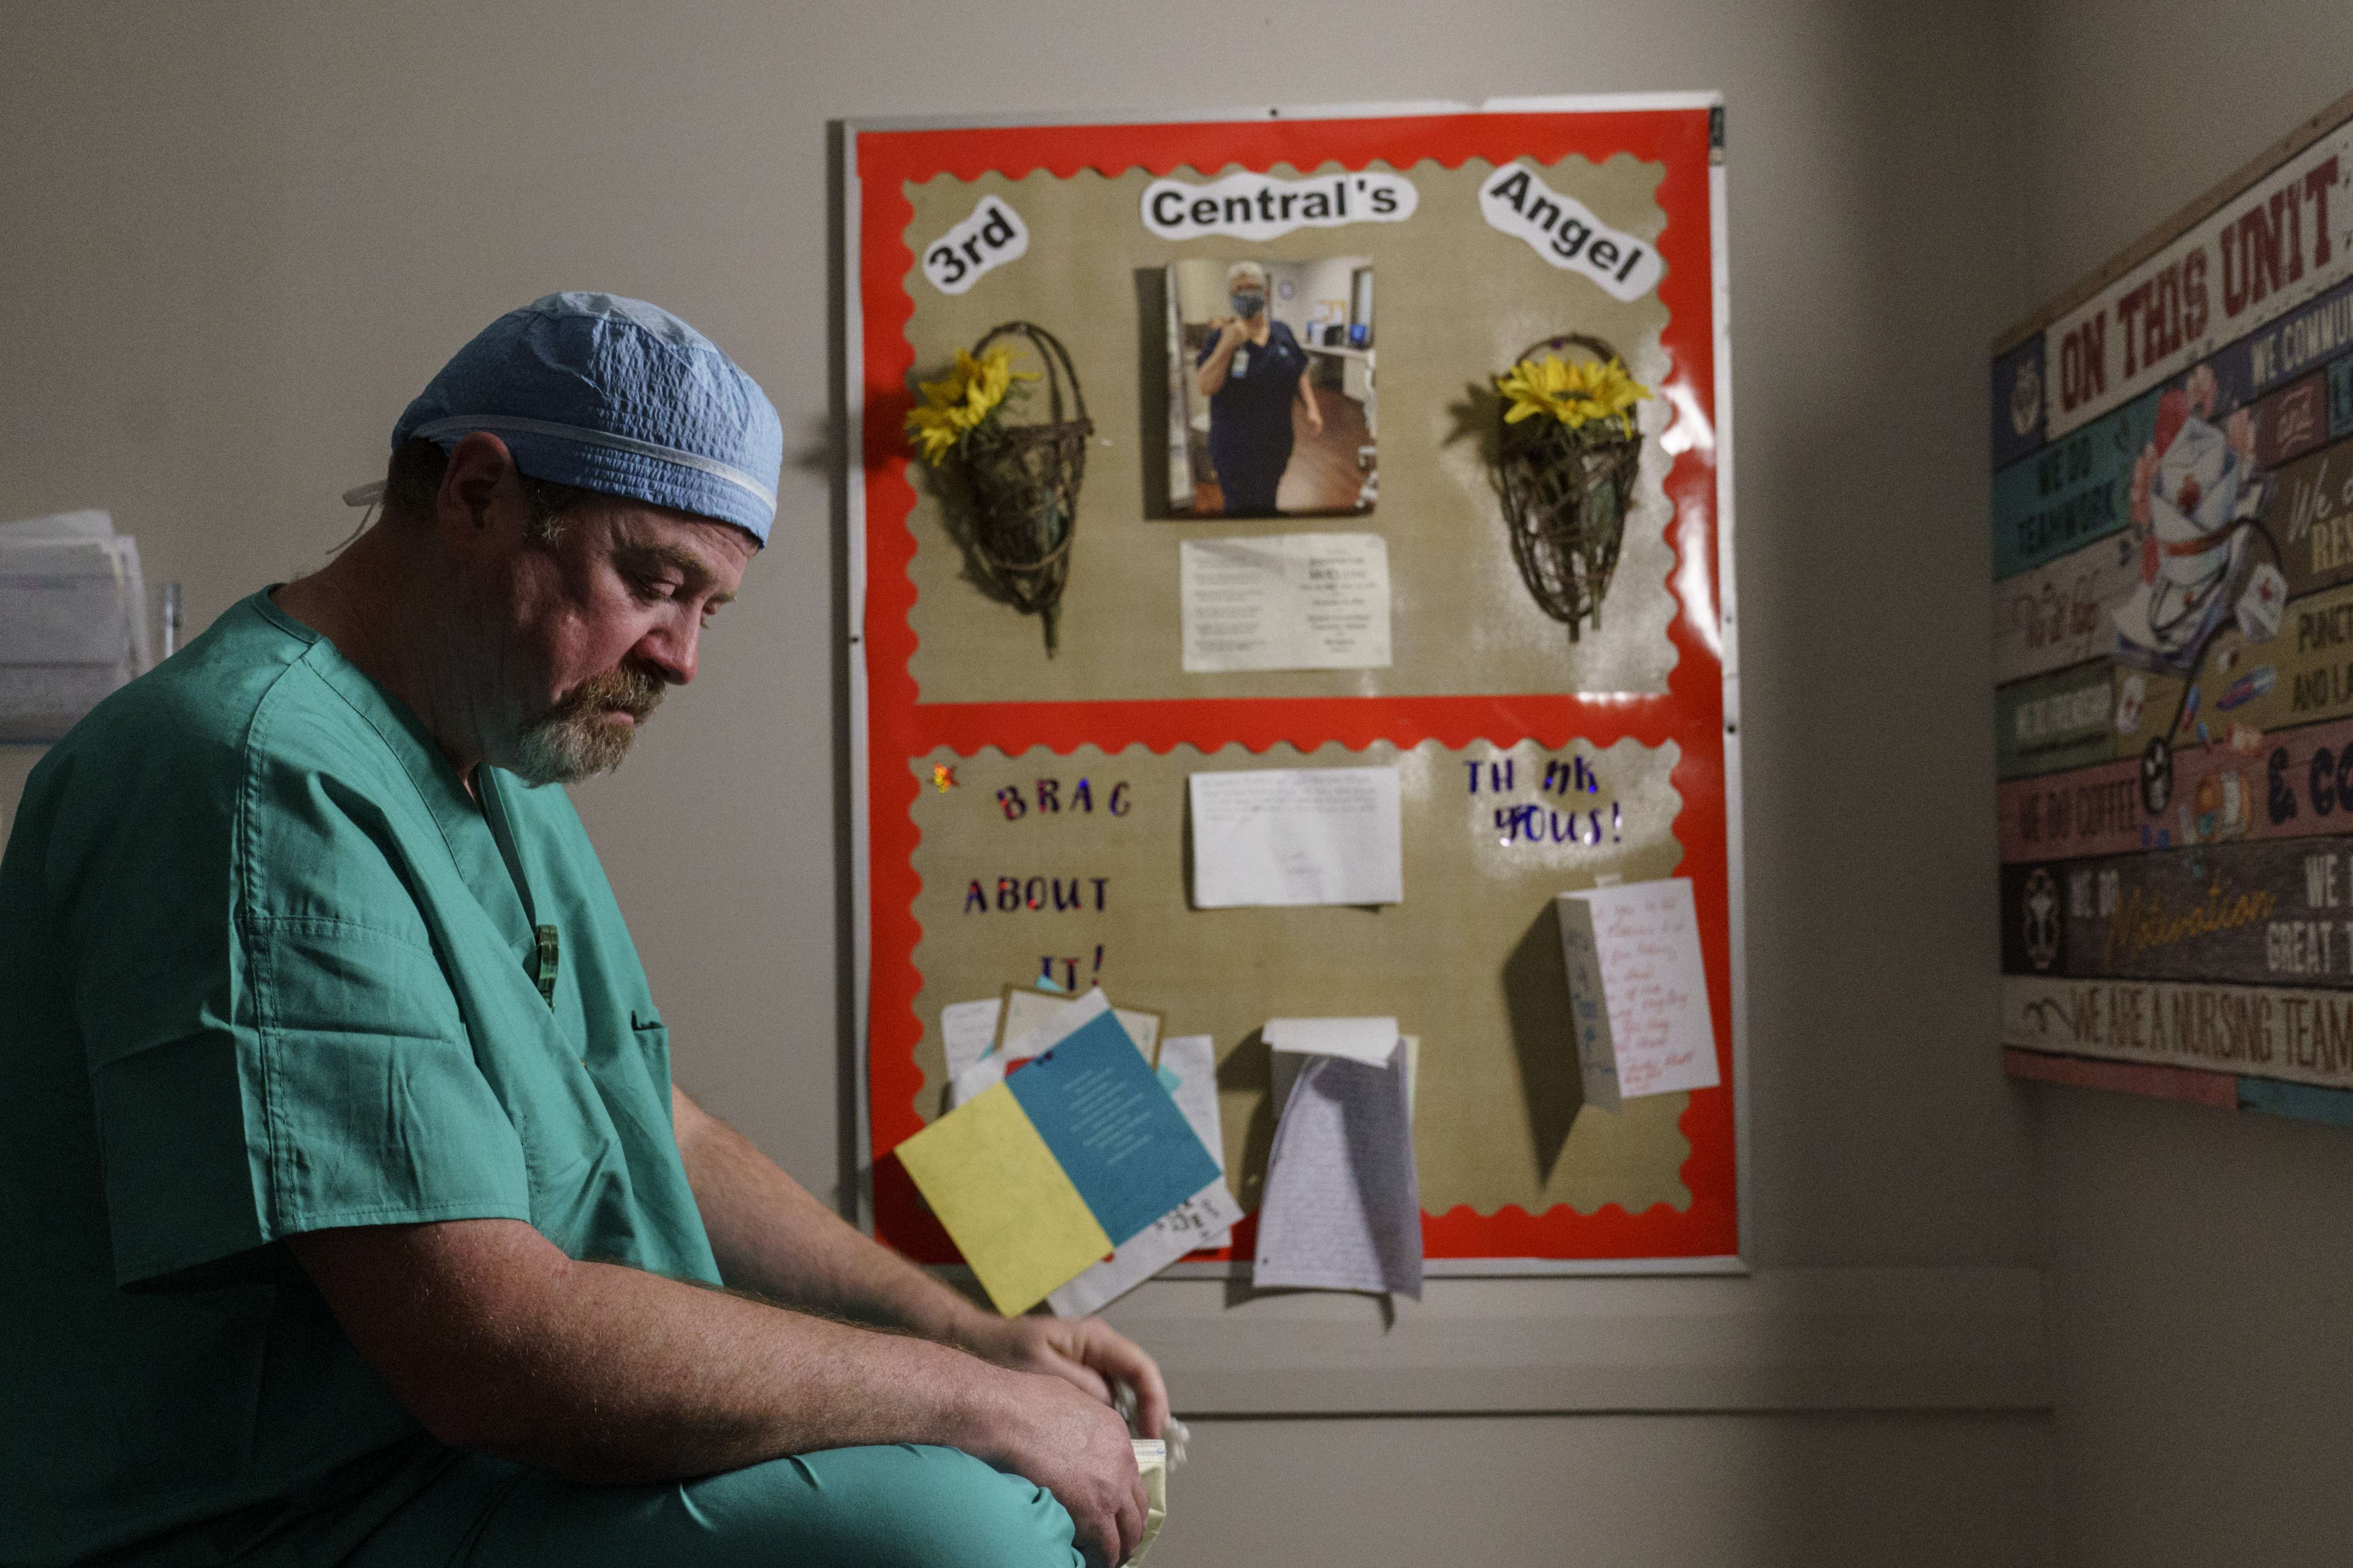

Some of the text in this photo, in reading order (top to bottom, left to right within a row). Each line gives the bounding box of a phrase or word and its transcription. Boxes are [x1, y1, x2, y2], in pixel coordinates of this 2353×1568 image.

[929, 170, 1642, 284] 3rd Central's Angel
[2061, 154, 2340, 412] ON THIS UNIT
[2282, 293, 2353, 372] COMMU
[964, 876, 1110, 913] ABOUT
[2304, 853, 2339, 908] WE
[2266, 920, 2333, 975] GREAT
[2072, 986, 2353, 1072] WE ARE A NURSING TEAM
